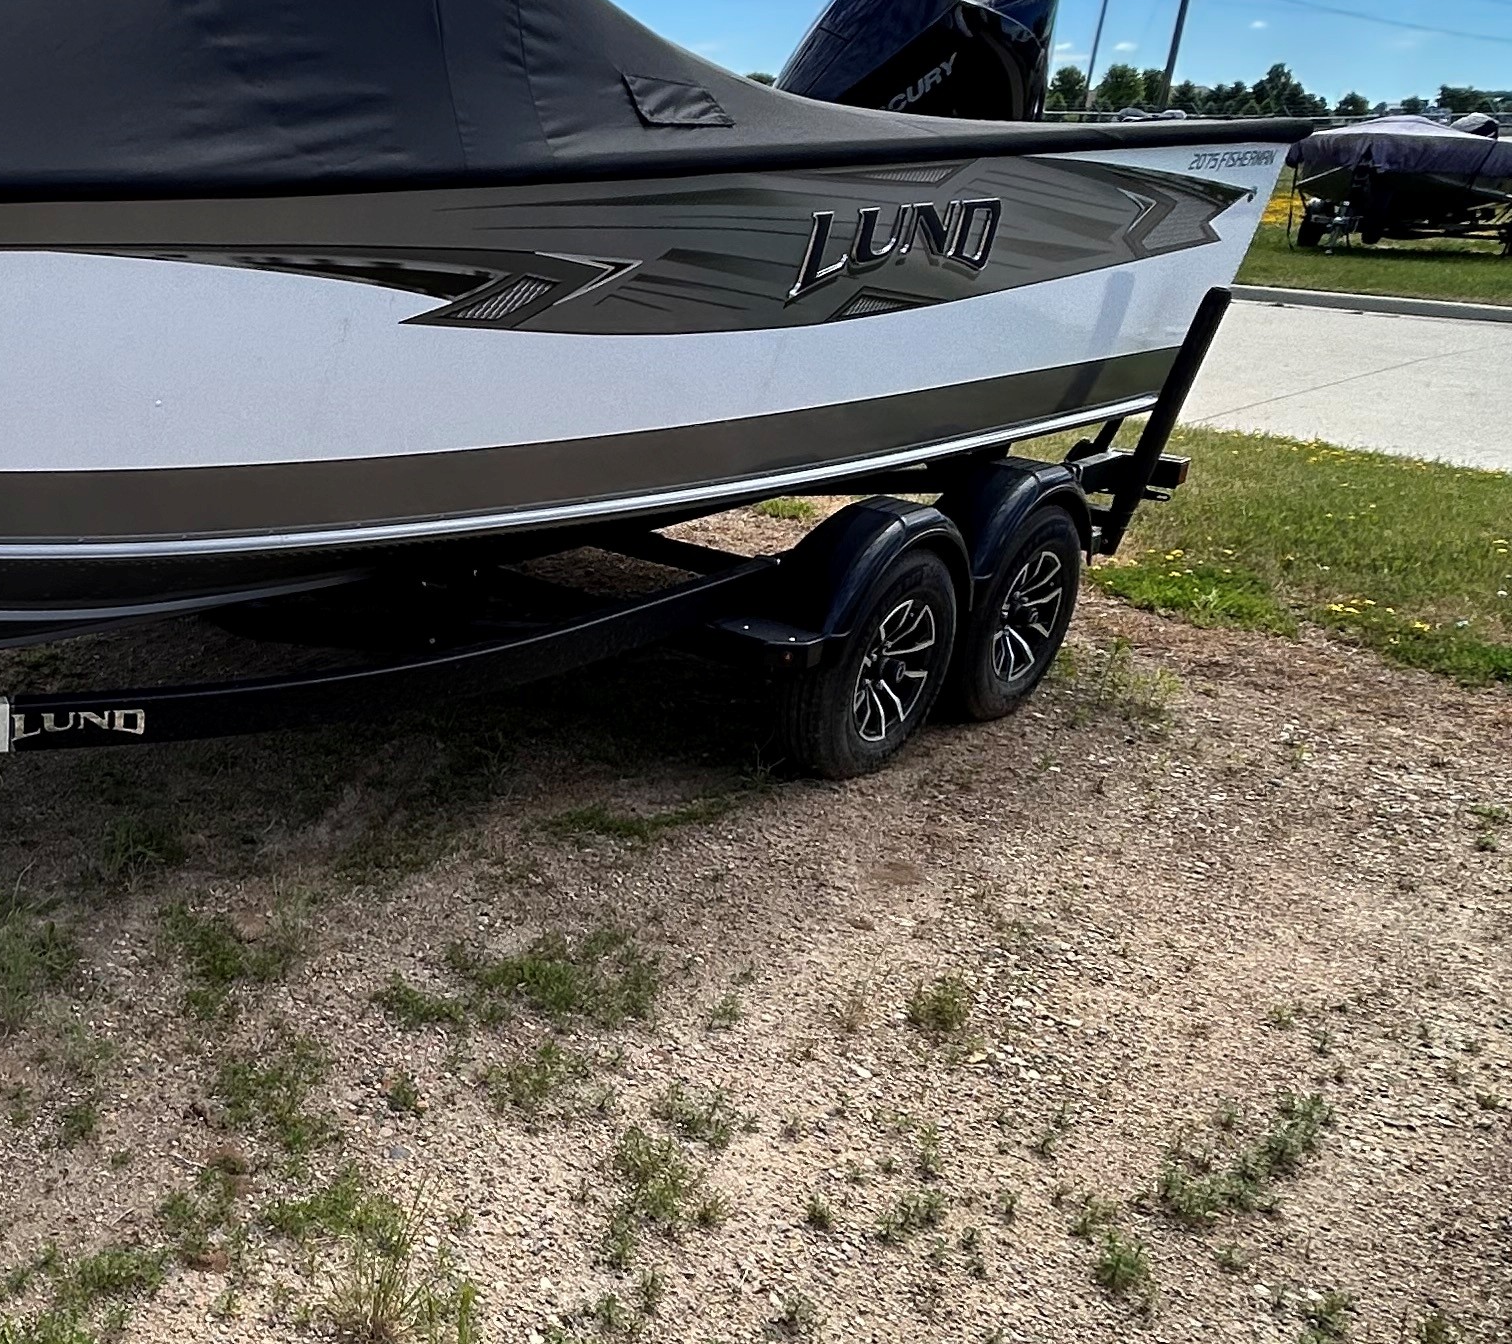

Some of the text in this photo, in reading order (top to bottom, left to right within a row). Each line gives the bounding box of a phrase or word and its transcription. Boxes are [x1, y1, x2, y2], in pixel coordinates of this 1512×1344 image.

[879, 51, 957, 112] CURY
[1188, 152, 1221, 170] 2075
[785, 197, 1001, 299] LUND
[11, 709, 145, 742] LUND
